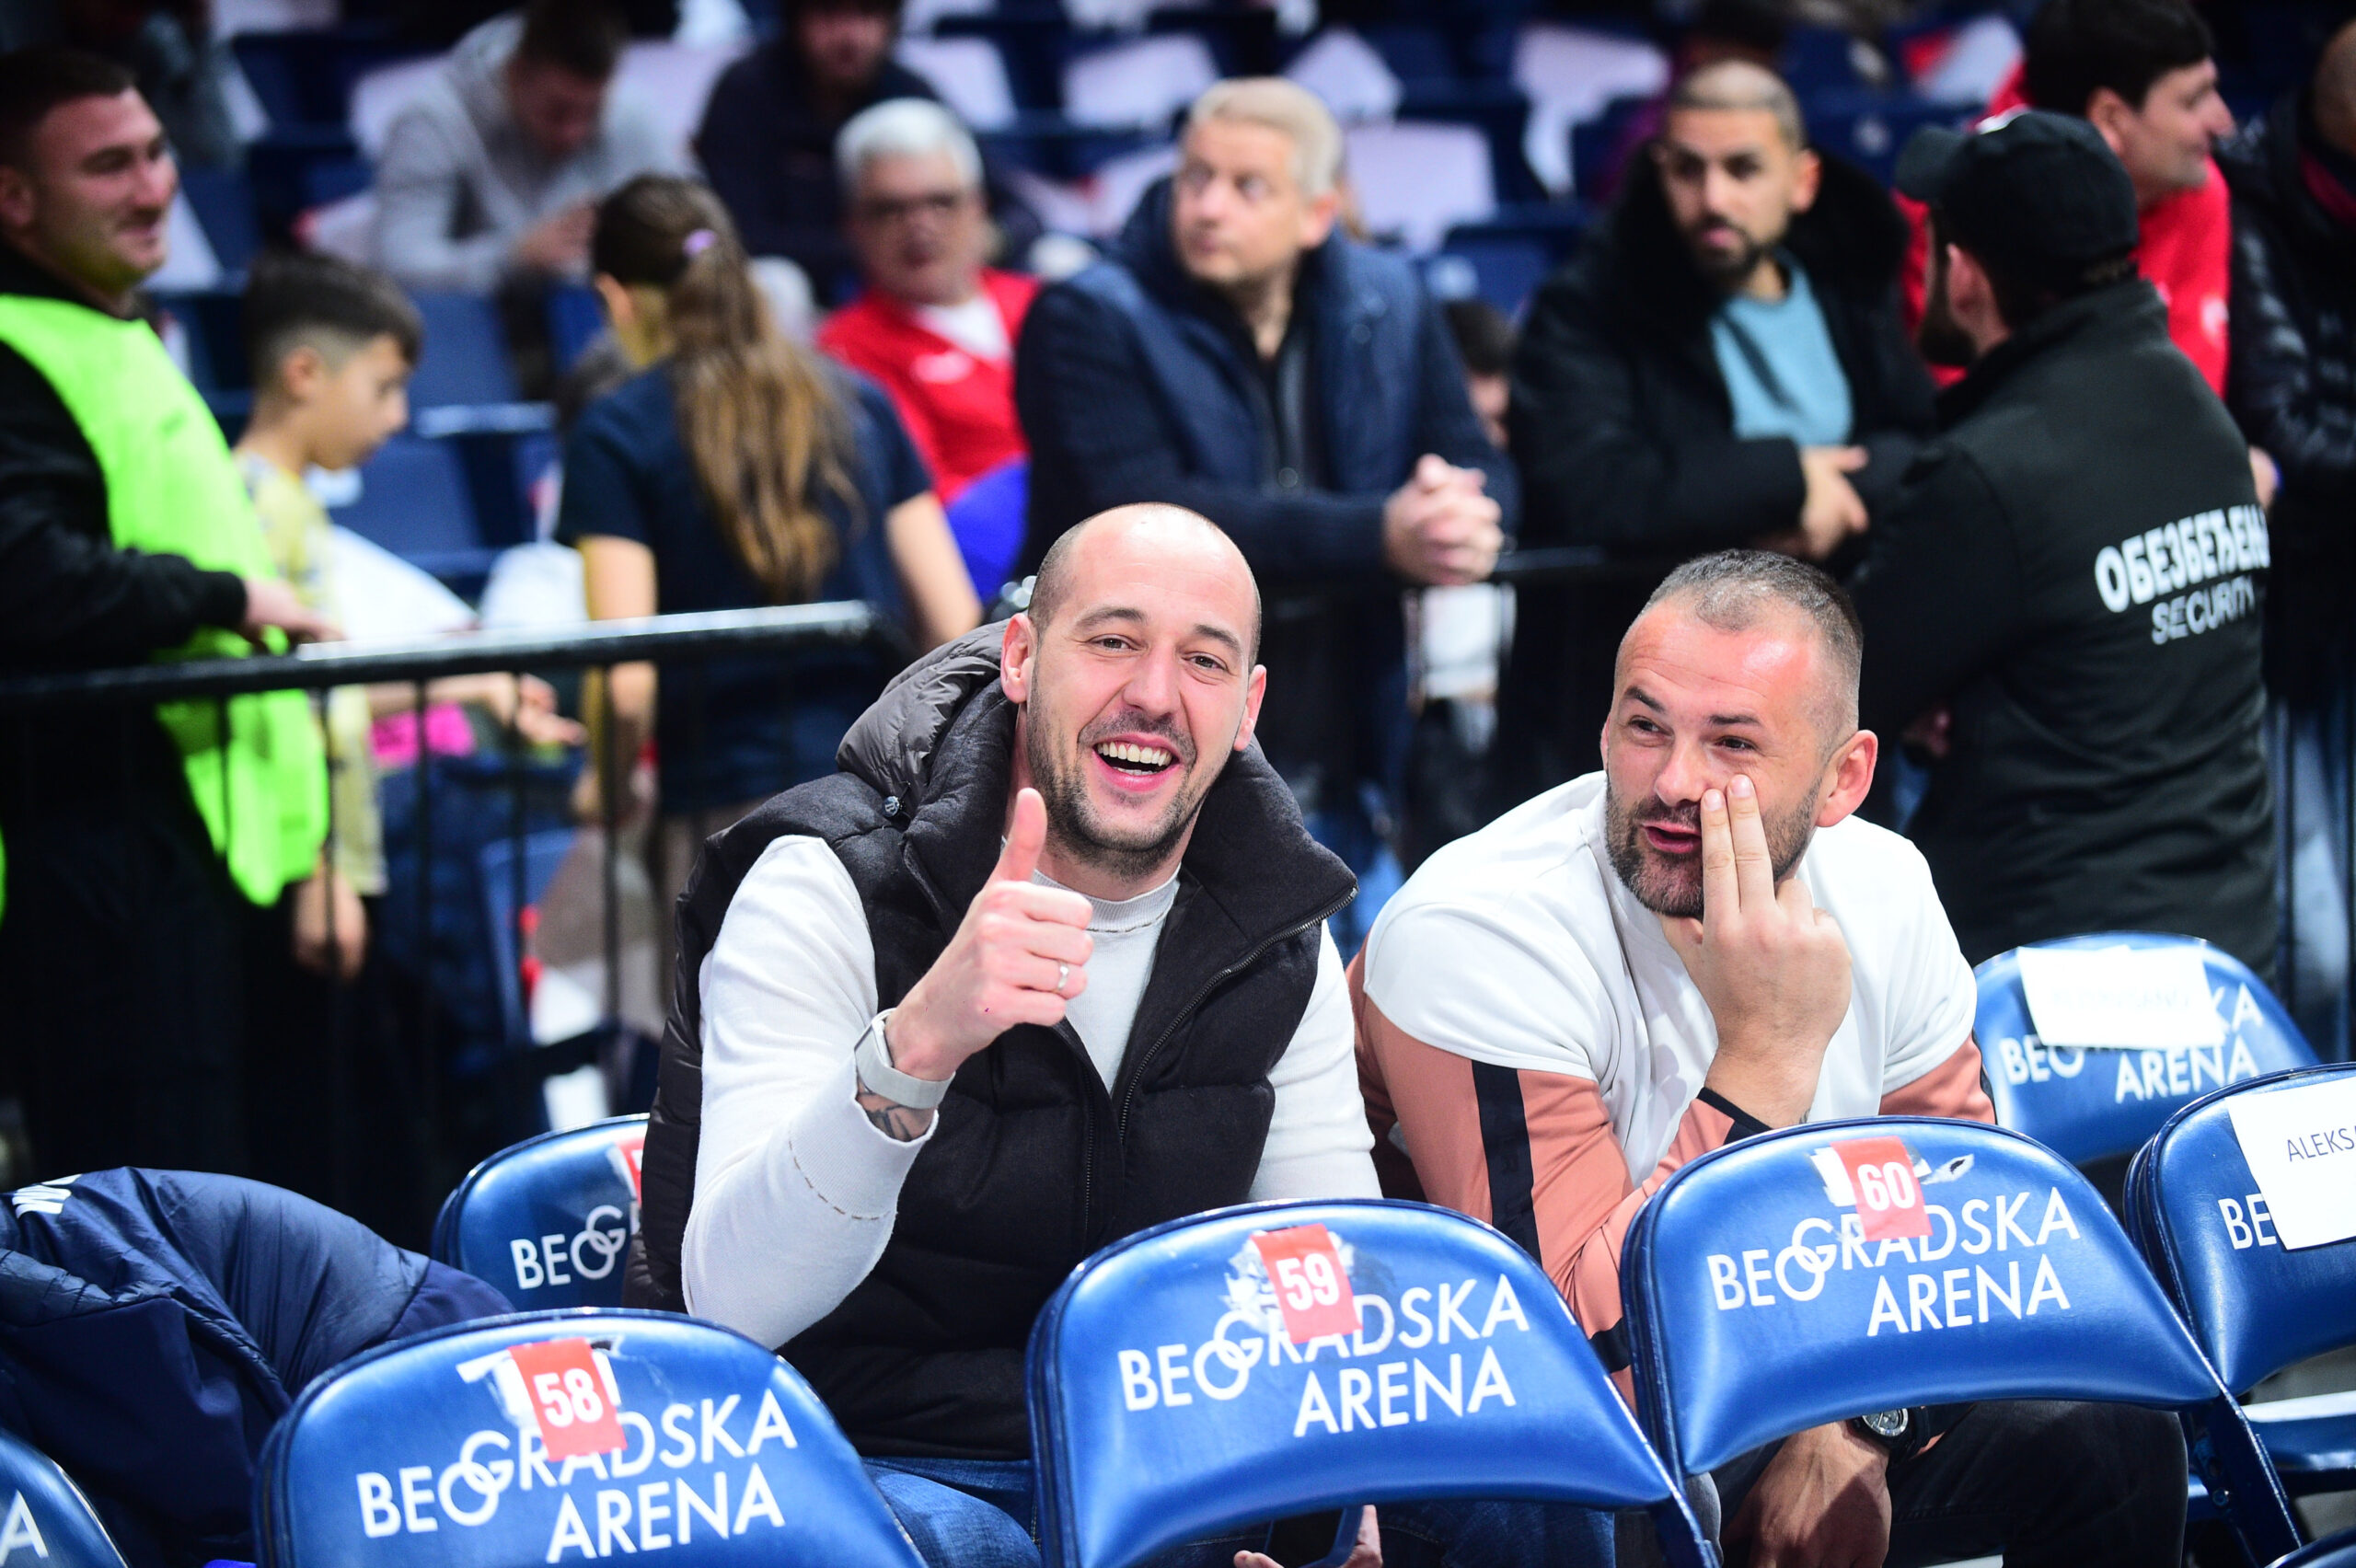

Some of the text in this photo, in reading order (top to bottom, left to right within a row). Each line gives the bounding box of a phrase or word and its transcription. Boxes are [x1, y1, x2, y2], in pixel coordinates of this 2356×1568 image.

[2115, 1034, 2259, 1103] ARENA
[2287, 1125, 2356, 1162] ALEKS
[1856, 1161, 1915, 1211] 60
[1276, 1253, 1340, 1311] 59
[1867, 1254, 2071, 1336] ARENA
[533, 1367, 604, 1427] 58
[1294, 1345, 1516, 1437] ARENA
[546, 1462, 785, 1563] ARENA
